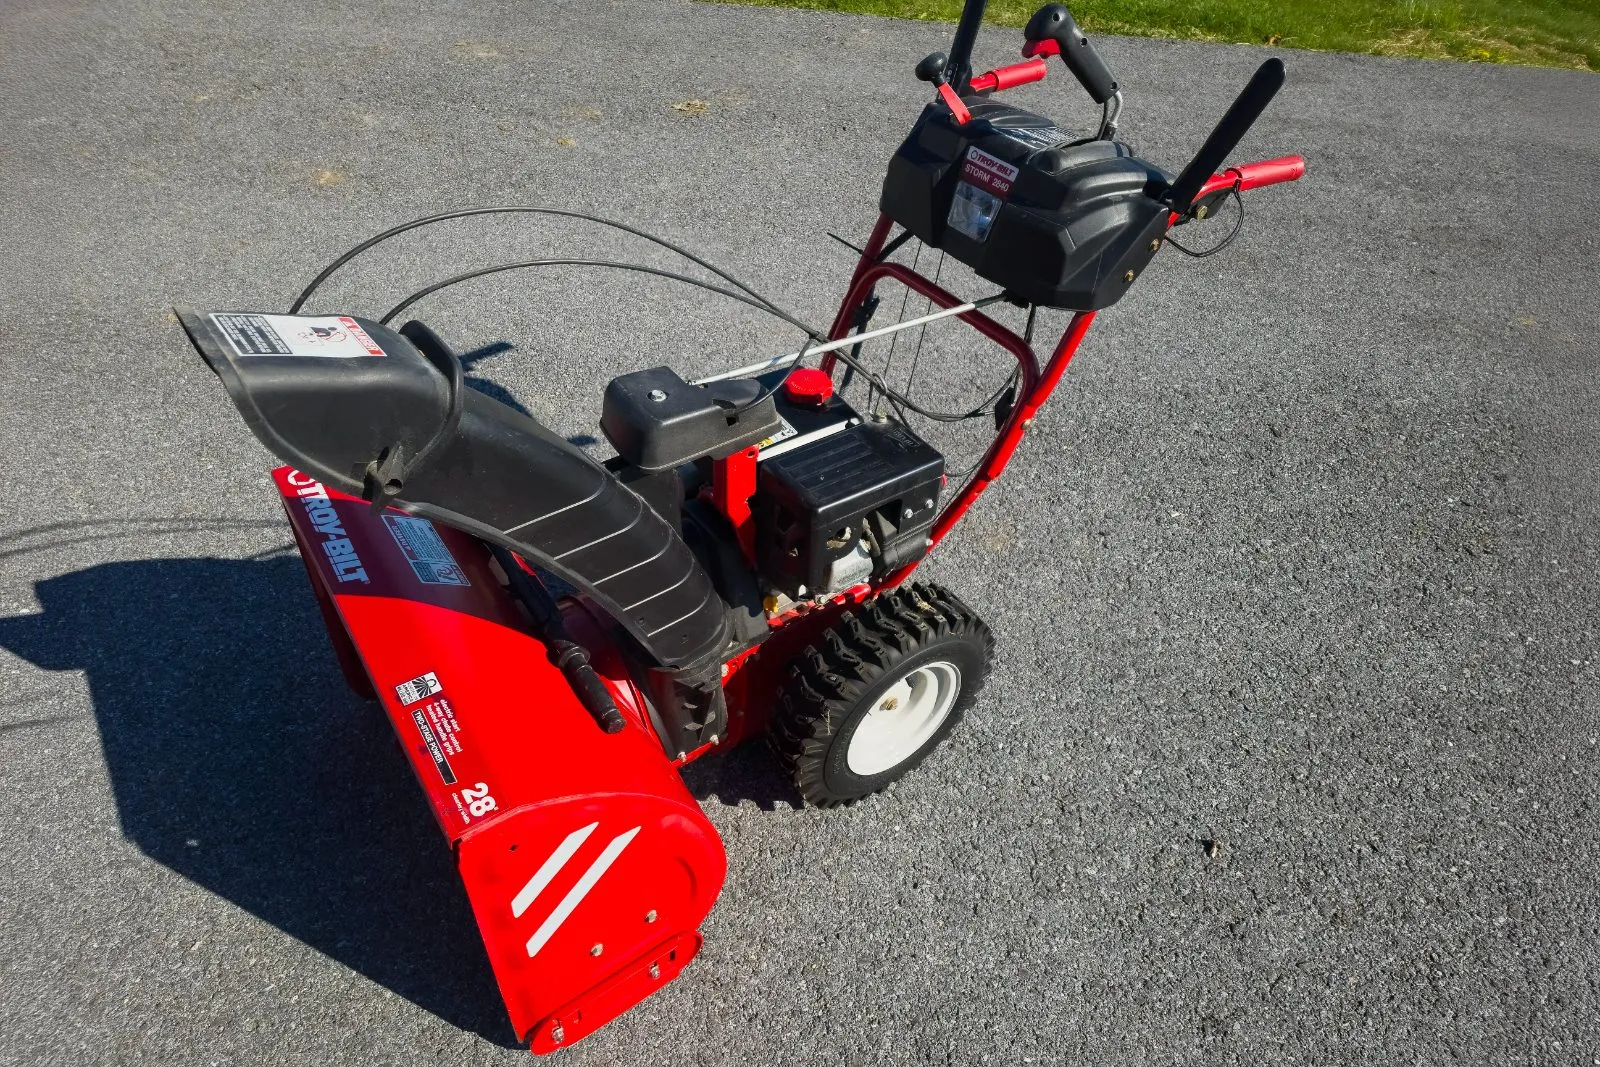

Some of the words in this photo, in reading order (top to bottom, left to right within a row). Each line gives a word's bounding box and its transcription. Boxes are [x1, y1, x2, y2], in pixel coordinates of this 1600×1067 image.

[965, 163, 991, 183] STORM
[991, 178, 1010, 192] 2840
[297, 482, 370, 584] TROY-BILT
[414, 711, 433, 743] TWO-STAGE
[428, 741, 444, 764] POWER
[426, 704, 439, 723] heated
[435, 721, 448, 742] handle
[443, 740, 455, 756] grips
[433, 702, 444, 718] 4-way
[440, 717, 452, 733] chute
[449, 732, 463, 753] control
[440, 699, 453, 719] electric
[450, 717, 461, 733] start
[459, 808, 470, 825] width
